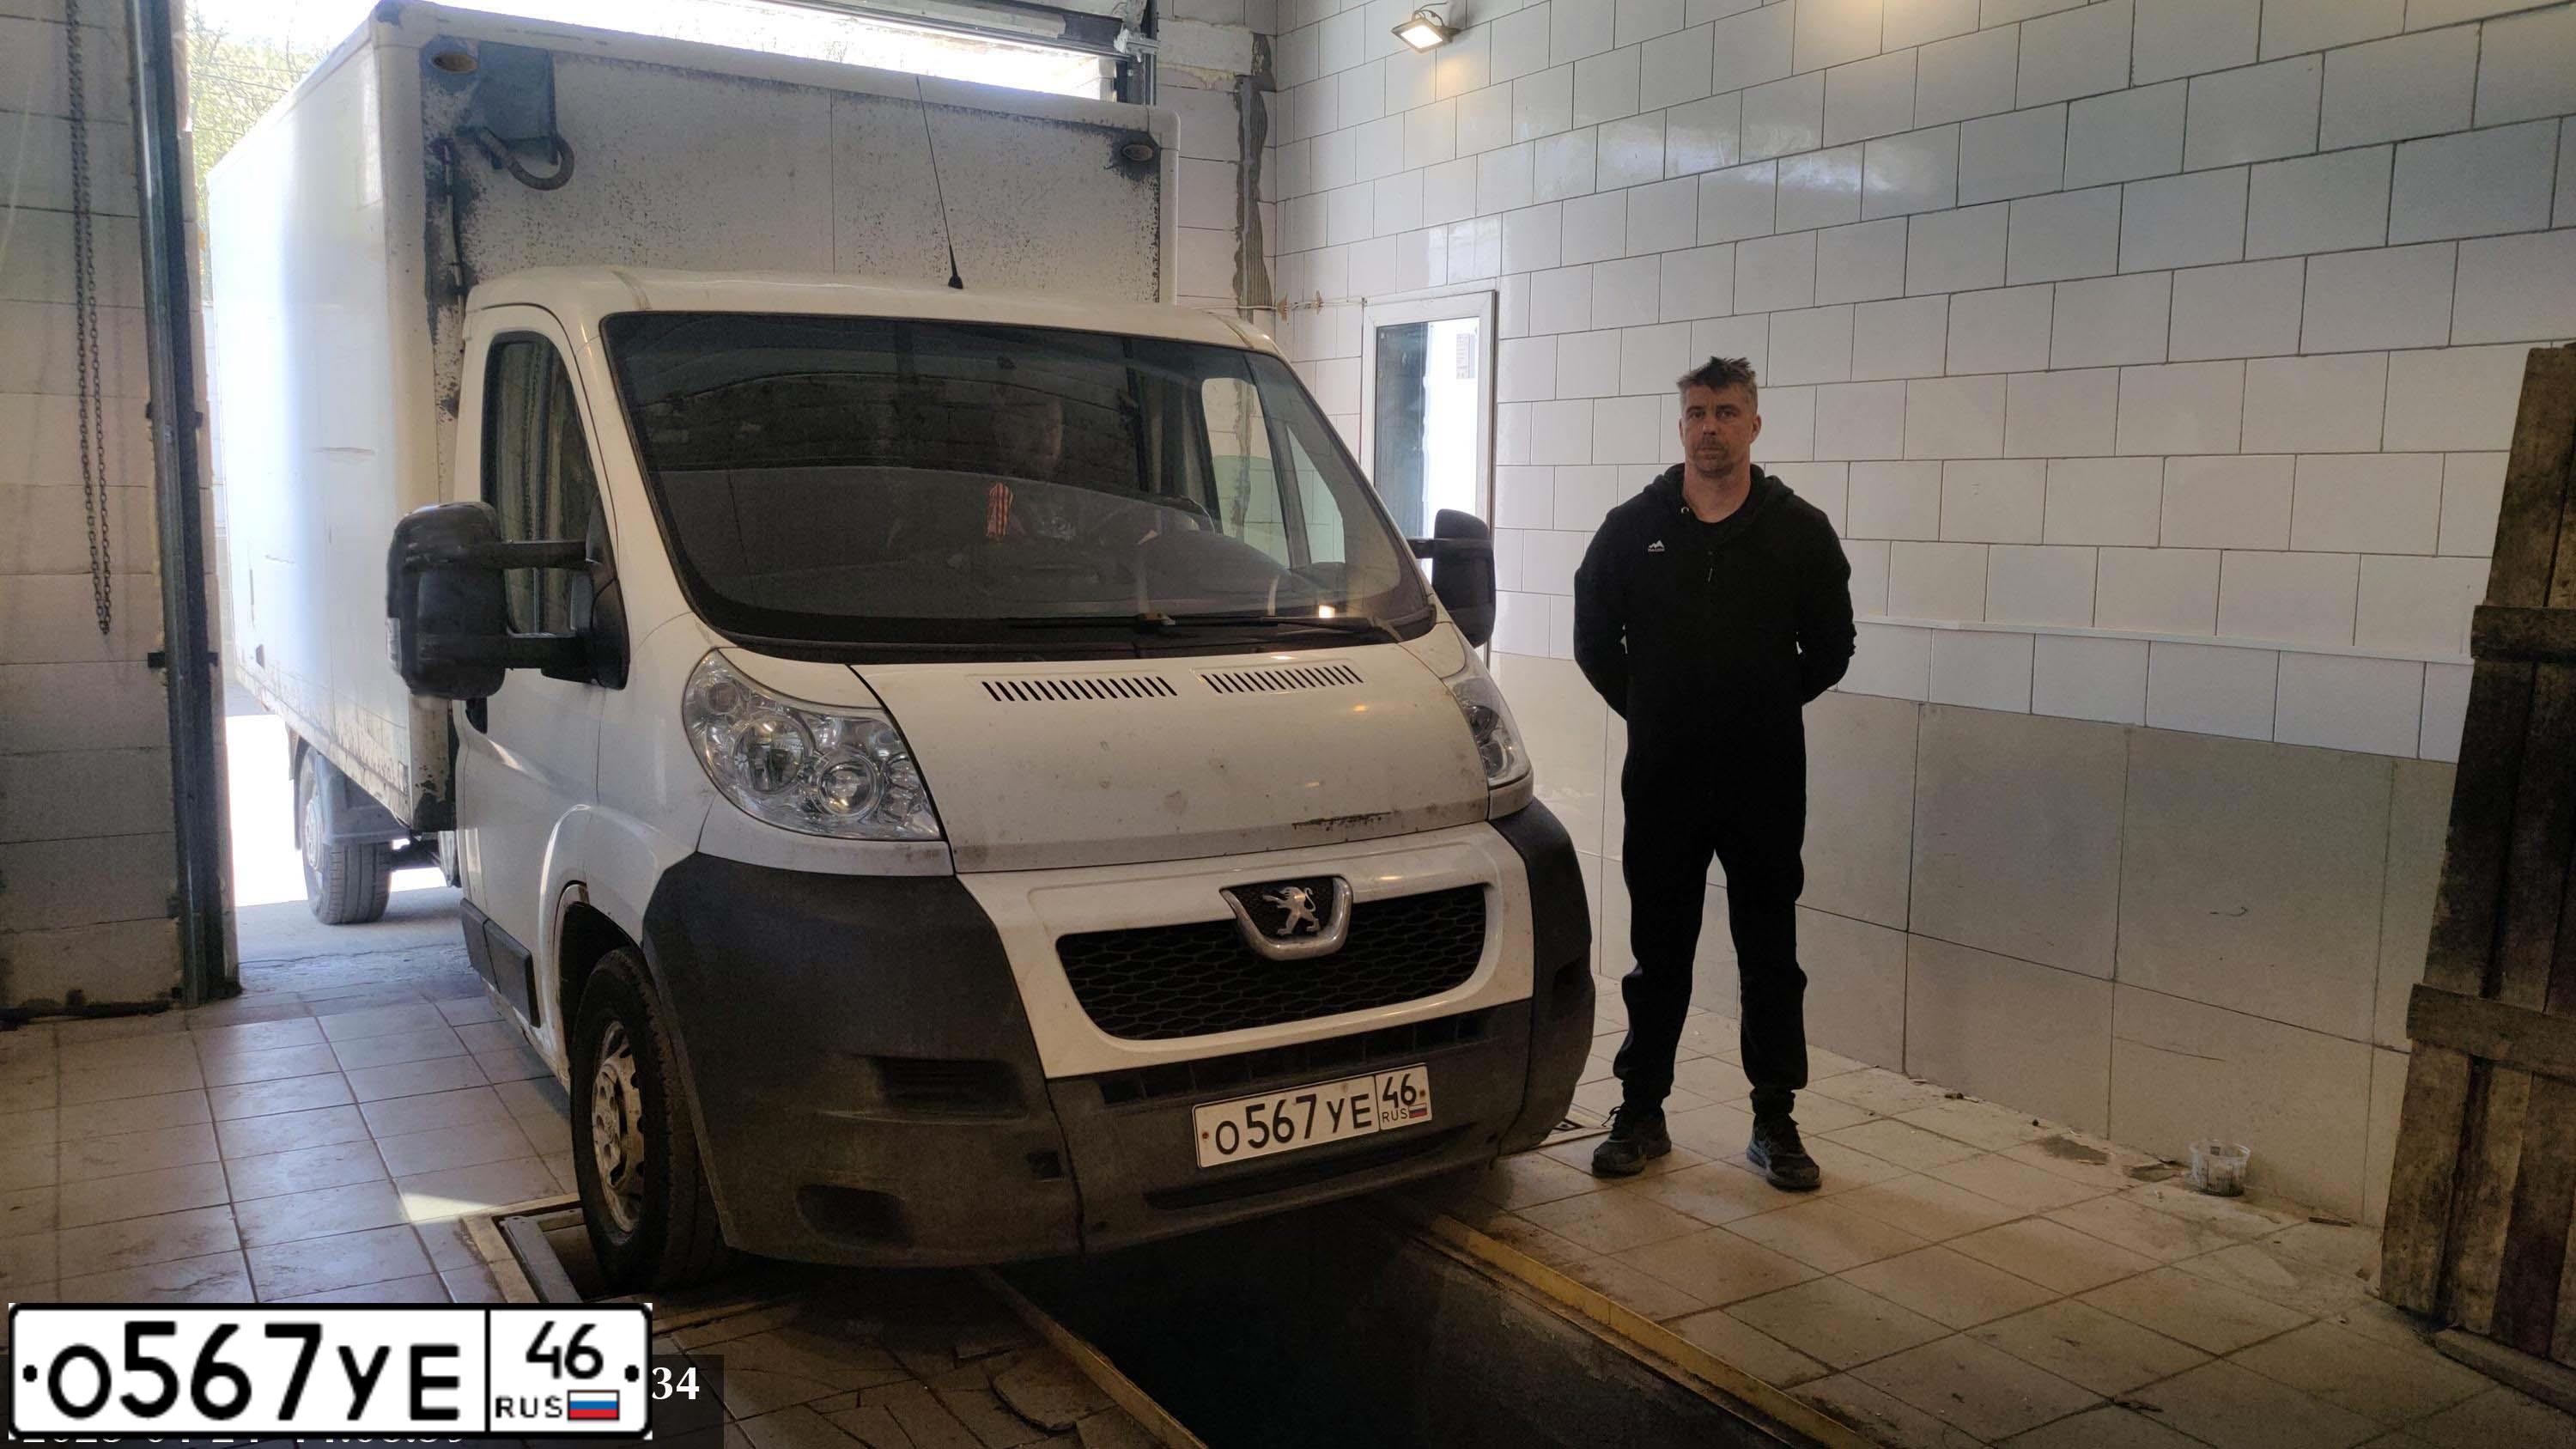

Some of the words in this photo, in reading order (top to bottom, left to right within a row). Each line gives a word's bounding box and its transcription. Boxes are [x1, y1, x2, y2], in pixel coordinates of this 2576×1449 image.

[1215, 1093, 1372, 1155] О567УЕ
[1382, 1074, 1417, 1109] 46
[1382, 1110, 1408, 1123] RUS
